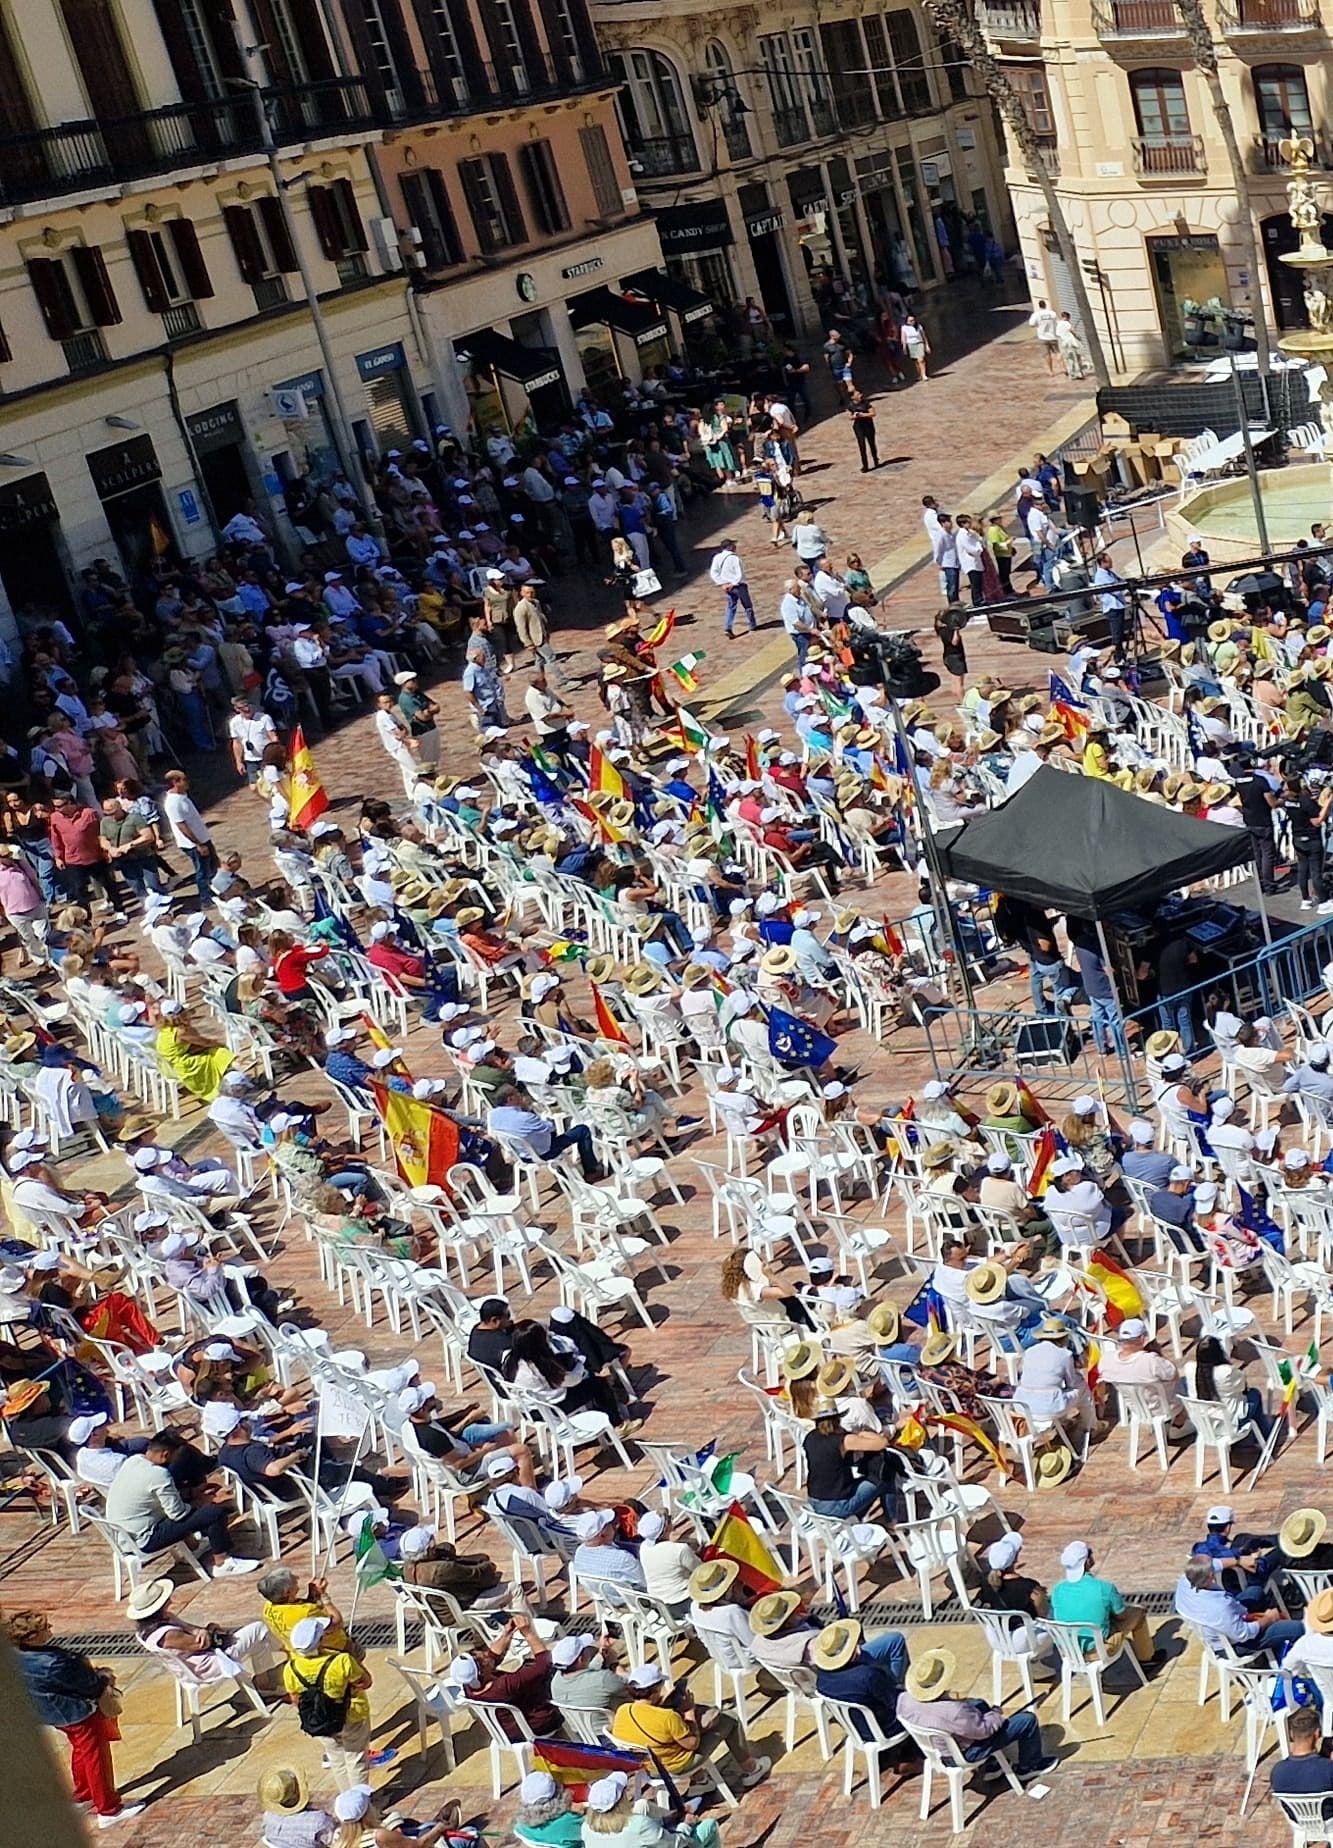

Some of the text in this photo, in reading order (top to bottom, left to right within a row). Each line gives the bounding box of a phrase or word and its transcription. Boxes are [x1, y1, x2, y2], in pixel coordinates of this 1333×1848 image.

[567, 257, 606, 279] STARBUCKS
[684, 303, 713, 324] STARBUCKS
[636, 323, 668, 346] STARBUCKS
[524, 369, 561, 393] STARBUCKS
[189, 411, 235, 437] LODGING
